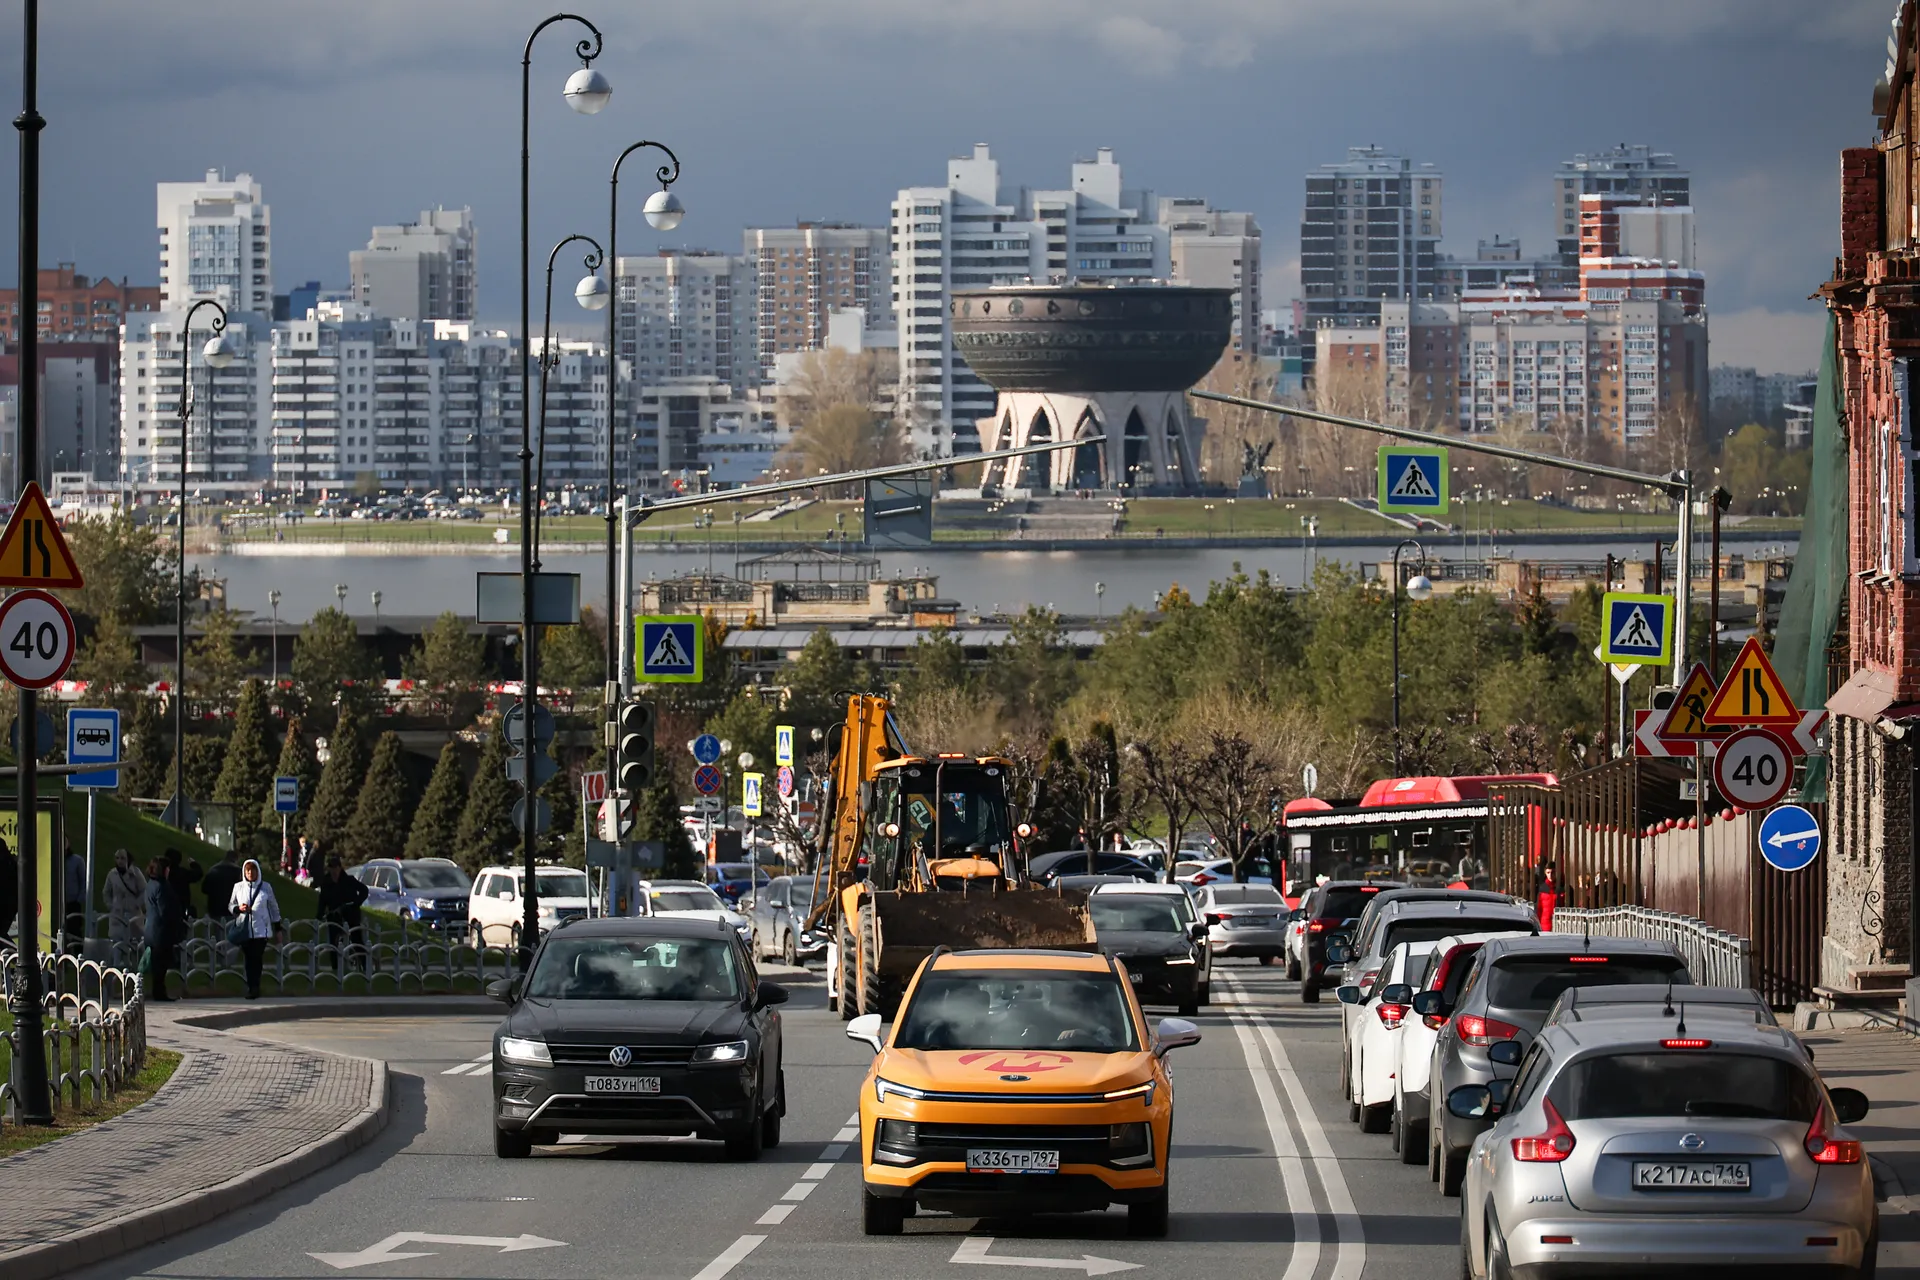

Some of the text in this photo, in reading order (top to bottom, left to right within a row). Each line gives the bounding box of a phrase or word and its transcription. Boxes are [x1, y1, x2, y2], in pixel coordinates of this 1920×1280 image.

[10, 621, 59, 660] 40
[1732, 754, 1778, 786] 40
[588, 1077, 657, 1091] Т083УН 116
[972, 1151, 1056, 1167] К336ТР 797
[1640, 1165, 1745, 1184] К217АС 716
[1527, 1195, 1564, 1204] JUKE
